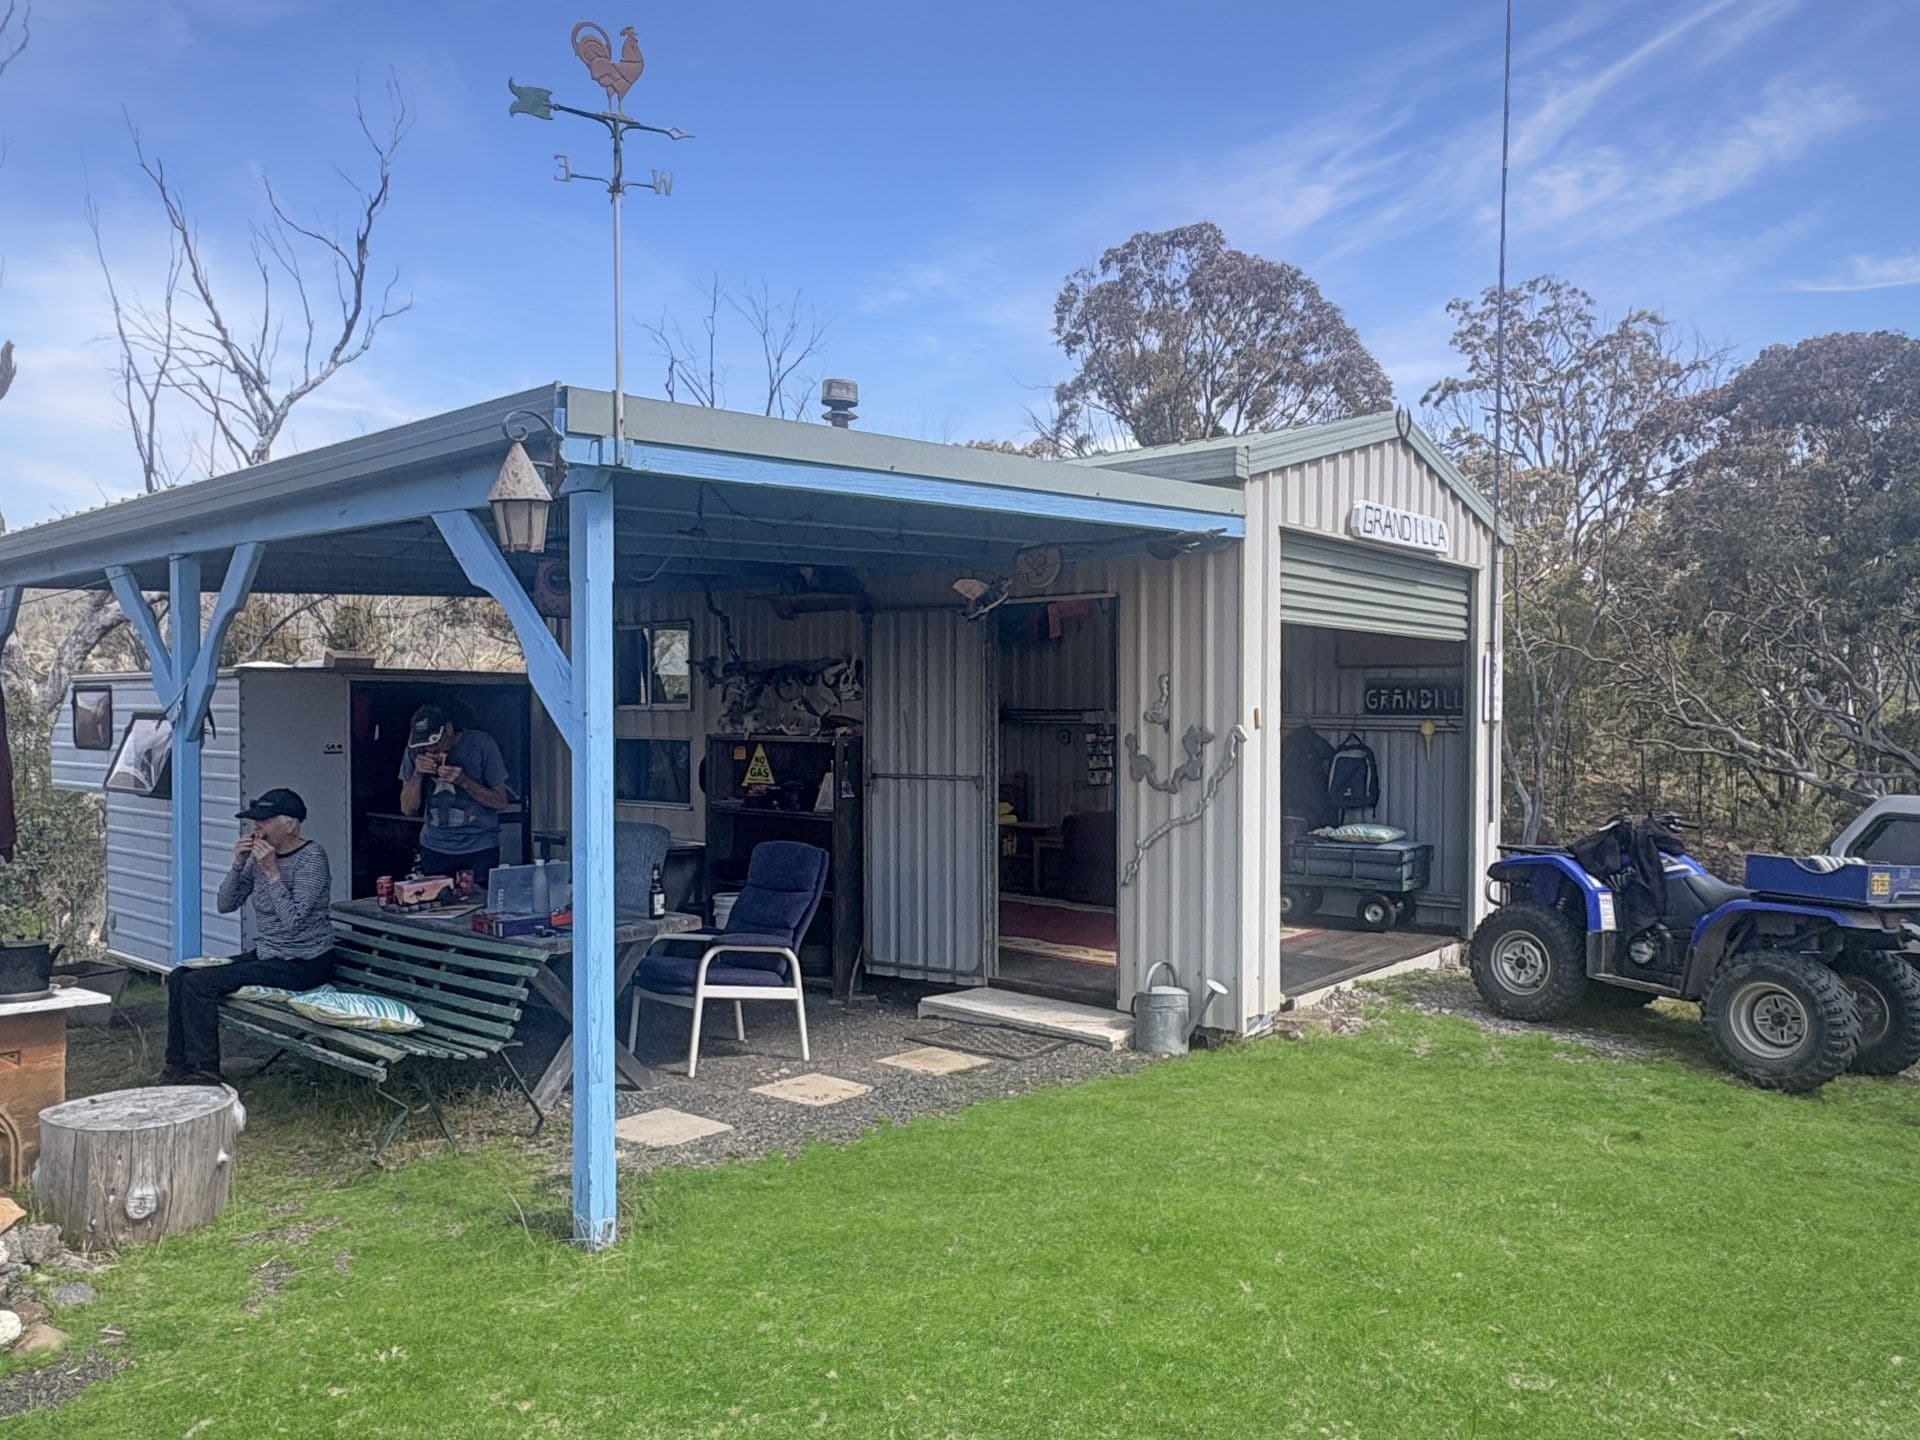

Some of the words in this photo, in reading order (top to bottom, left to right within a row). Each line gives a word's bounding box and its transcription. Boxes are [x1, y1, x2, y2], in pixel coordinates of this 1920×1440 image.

[652, 169, 673, 197] W
[1363, 505, 1447, 548] GRANDILLA
[754, 755, 766, 764] NO
[750, 767, 769, 777] GAS
